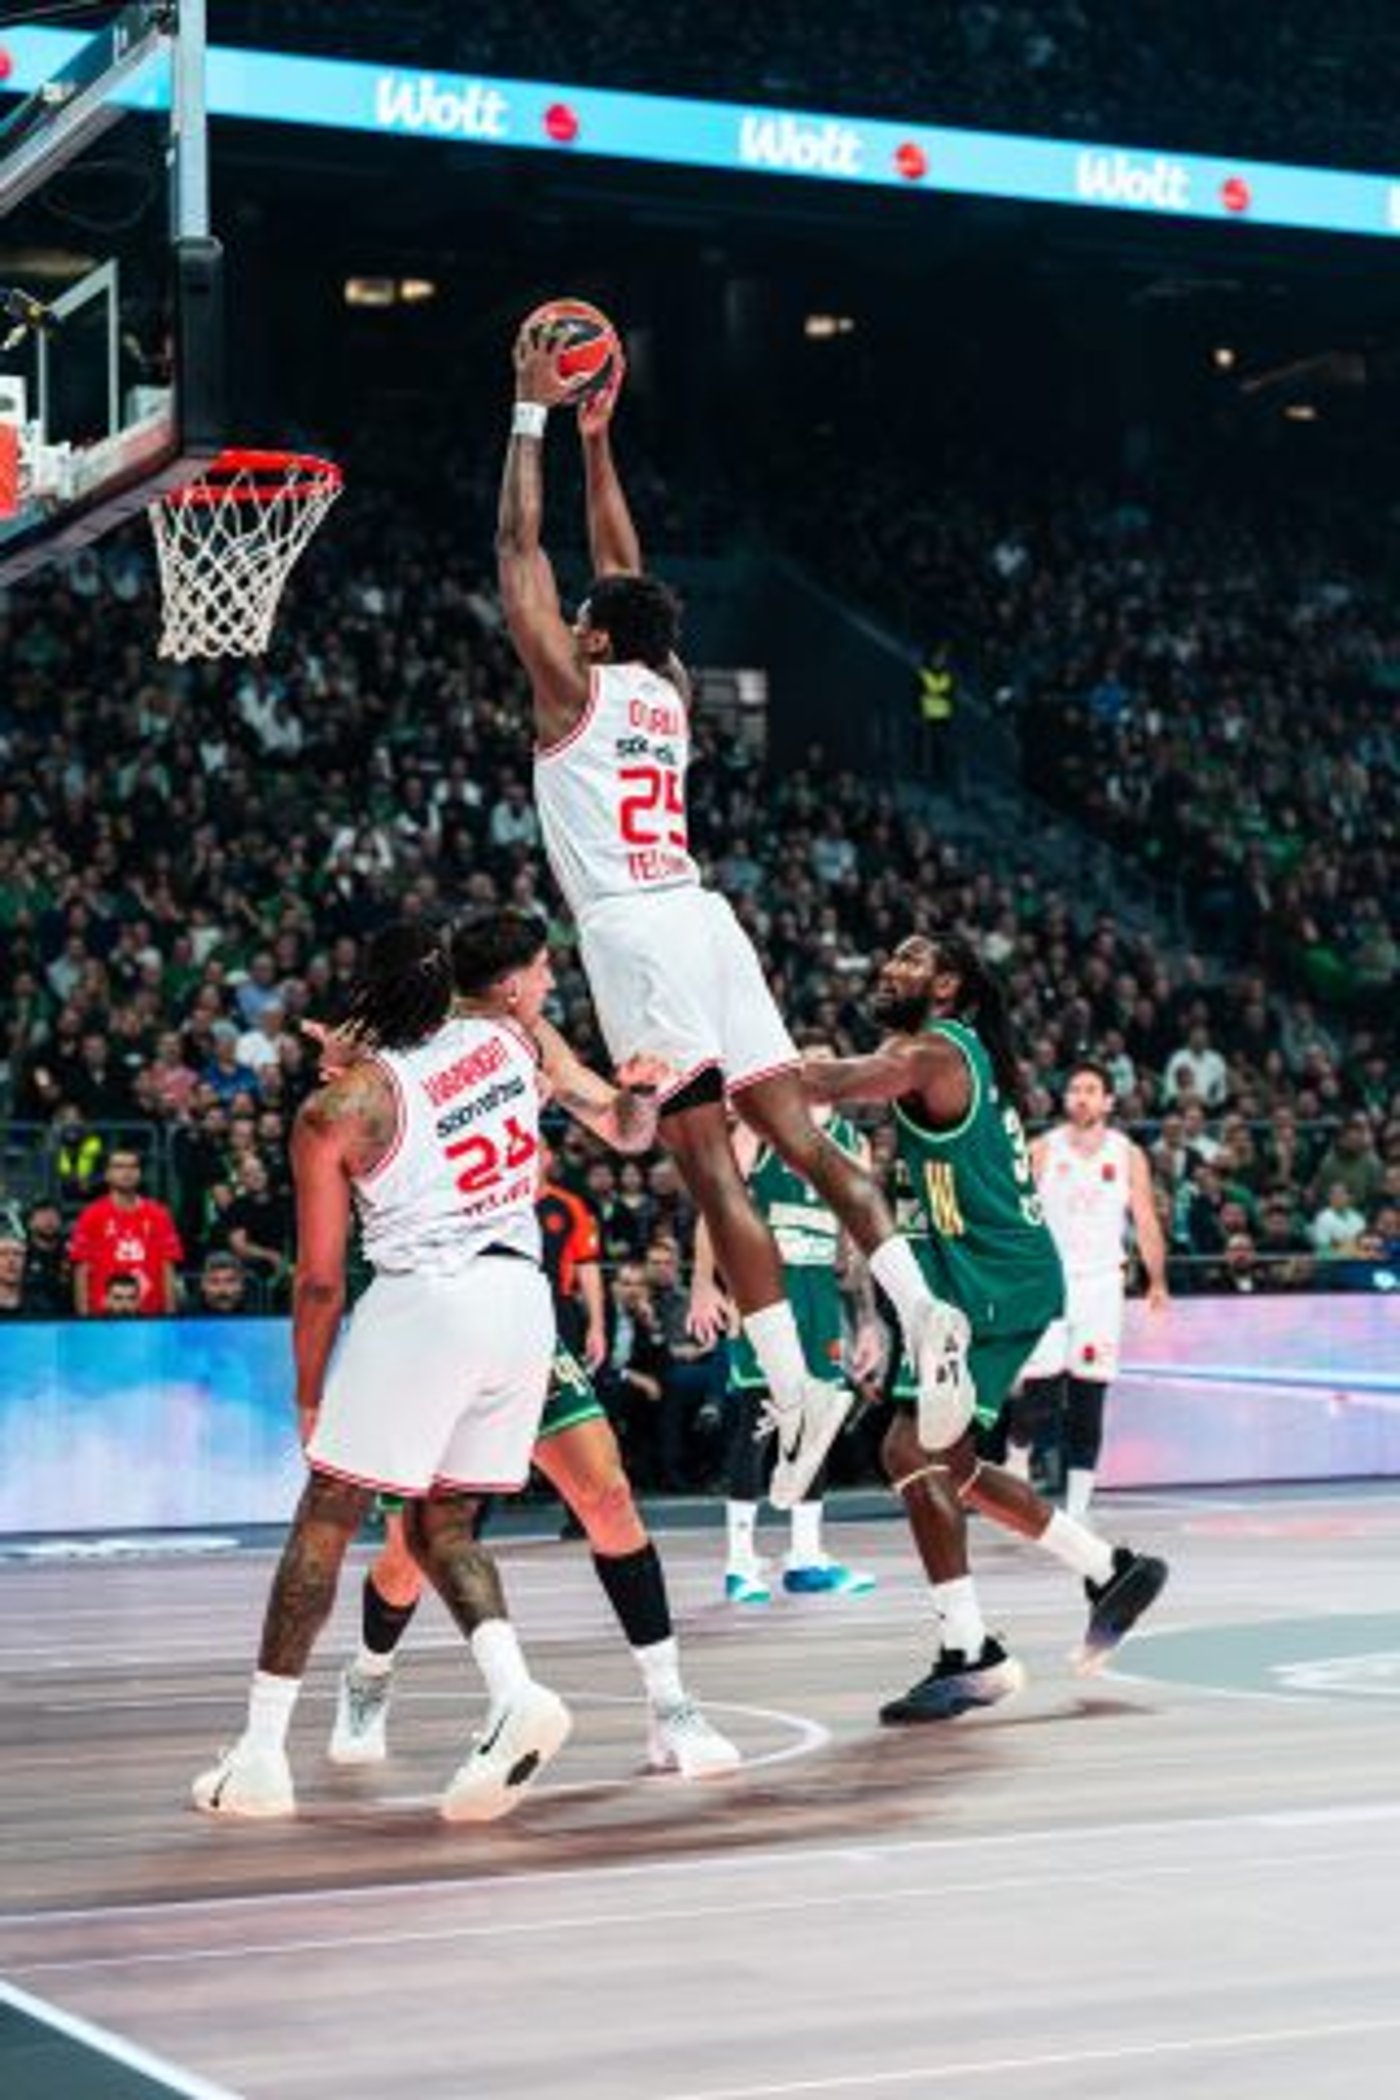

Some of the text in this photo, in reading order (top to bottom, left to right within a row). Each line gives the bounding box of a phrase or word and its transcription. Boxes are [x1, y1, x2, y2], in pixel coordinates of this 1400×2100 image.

[374, 76, 508, 137] Wolt
[739, 115, 860, 174] Wolt
[1077, 152, 1190, 209] Wolt
[618, 765, 688, 848] 25
